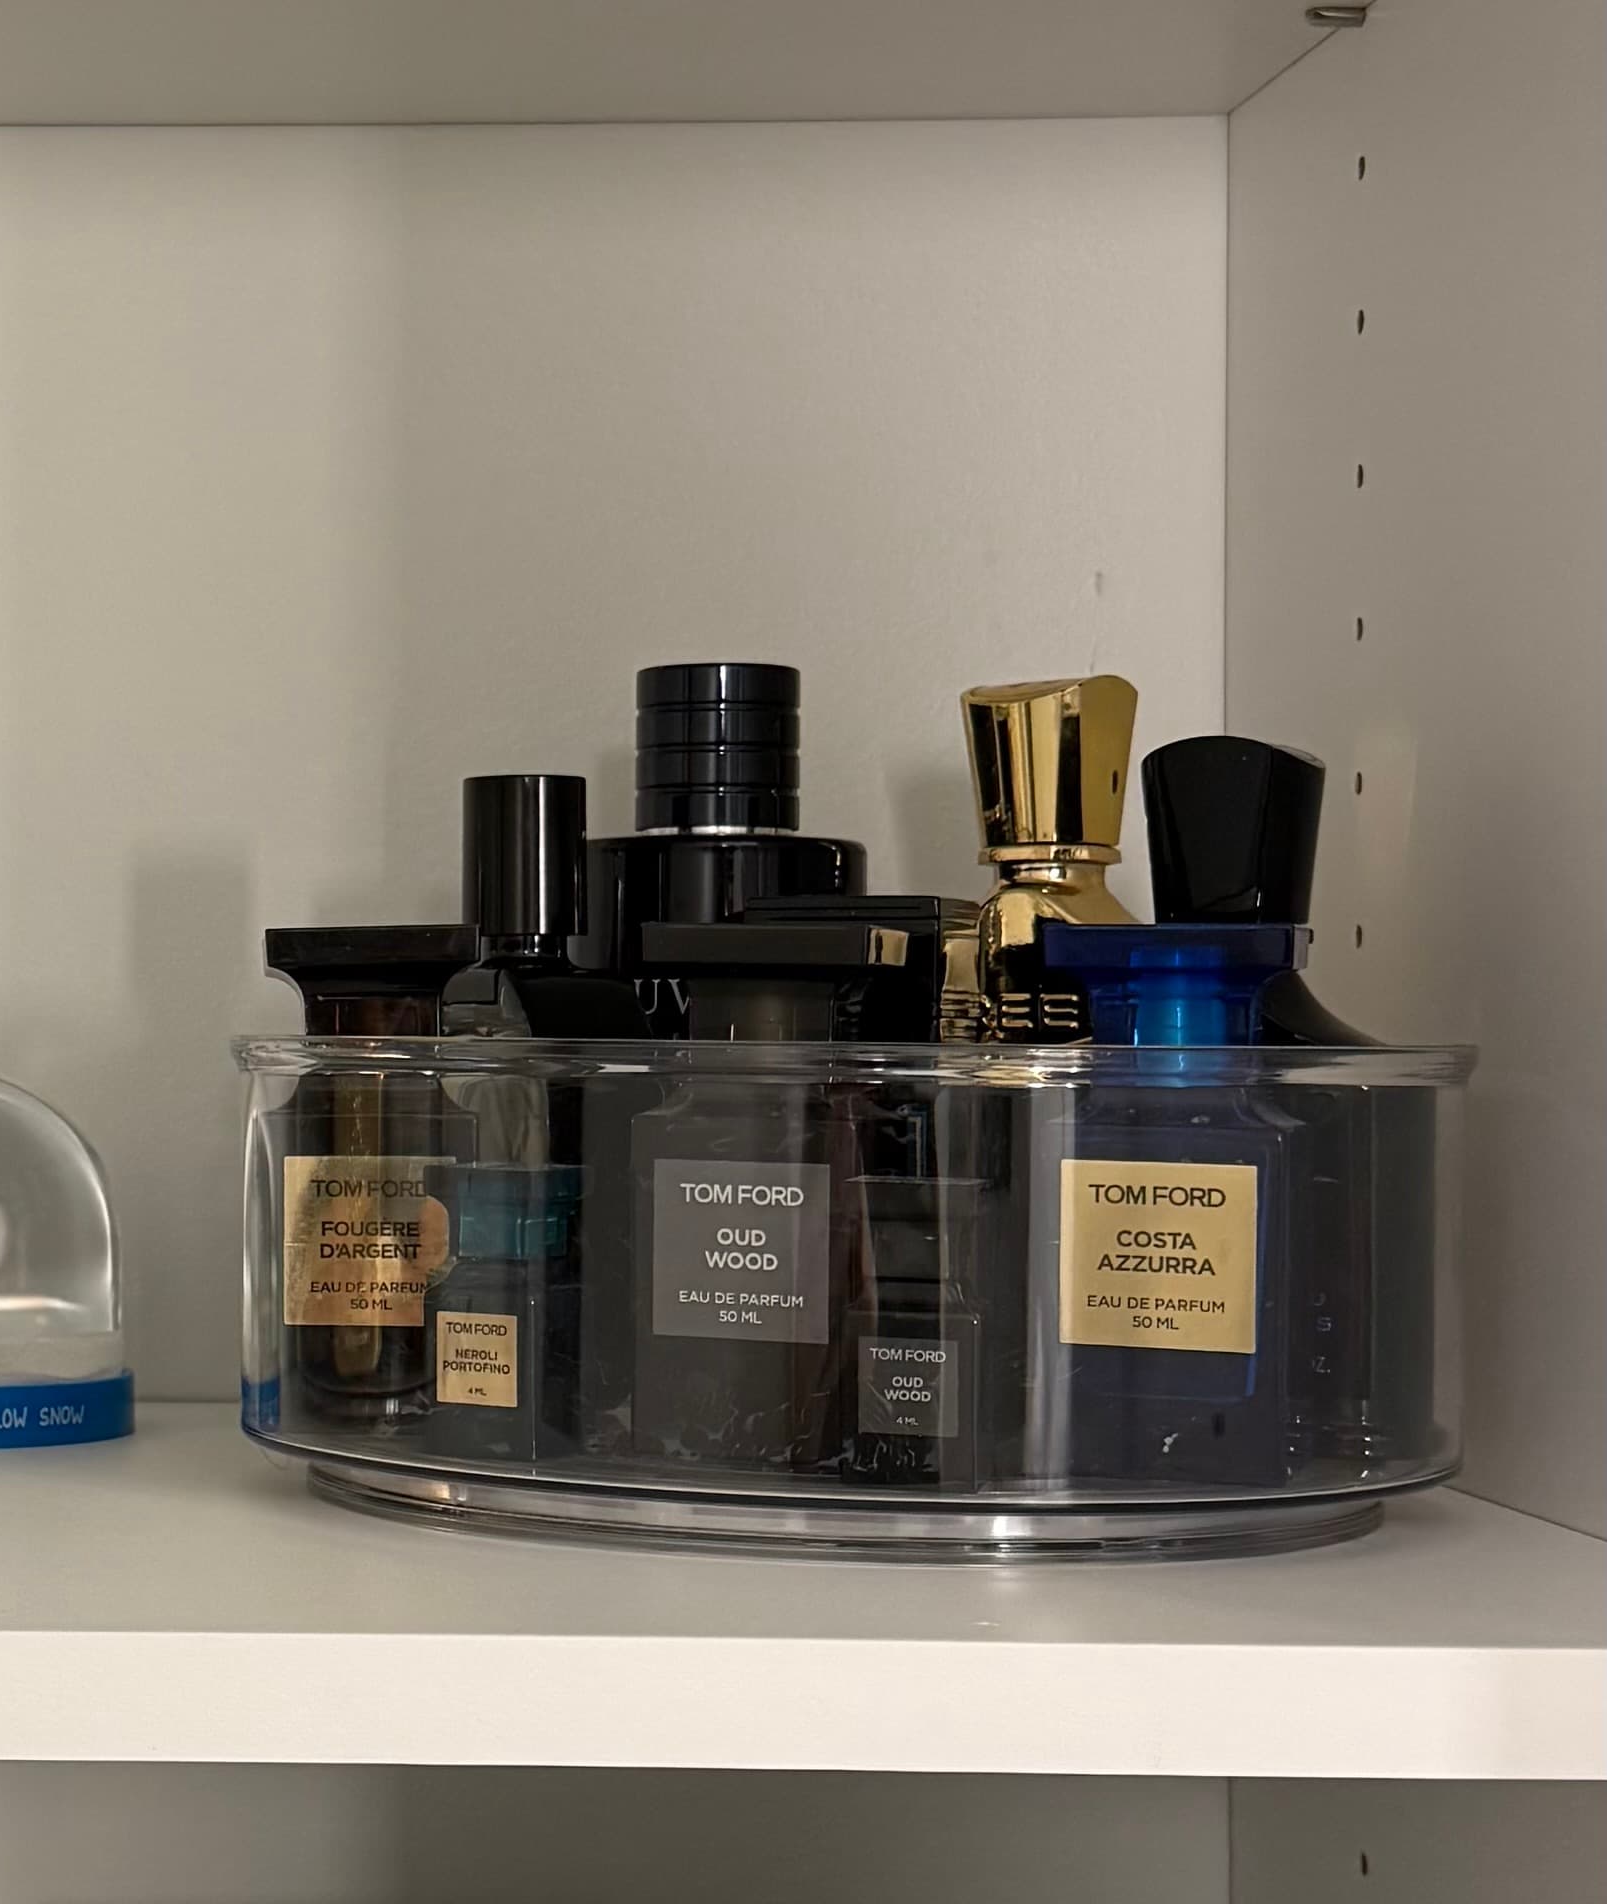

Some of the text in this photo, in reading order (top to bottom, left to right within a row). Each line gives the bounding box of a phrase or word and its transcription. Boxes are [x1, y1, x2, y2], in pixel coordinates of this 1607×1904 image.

[310, 1178, 363, 1198] TOM
[679, 1182, 804, 1207] TOM FORD
[1088, 1183, 1227, 1208] TOM FORD
[716, 1227, 767, 1247] OUD
[1115, 1229, 1198, 1251] COSTA
[320, 1243, 422, 1259] D'ARGENT
[704, 1249, 779, 1271] WOOD
[1096, 1254, 1216, 1277] AZZURRA
[310, 1280, 342, 1294] EAU
[350, 1298, 393, 1311] 50 ML
[678, 1289, 804, 1309] EAU DE PARFUM
[1086, 1294, 1226, 1314] EAU DE PARFUM
[718, 1309, 763, 1325] 50 ML
[1131, 1315, 1180, 1330] 50 ML
[446, 1321, 508, 1336] TOM FORD
[455, 1348, 498, 1362] NEROLI
[869, 1347, 947, 1363] TOM FORD
[442, 1360, 511, 1376] PORTOFINO
[892, 1376, 924, 1388] OUD
[884, 1388, 932, 1402] WOOD
[39, 1404, 85, 1427] SNOW
